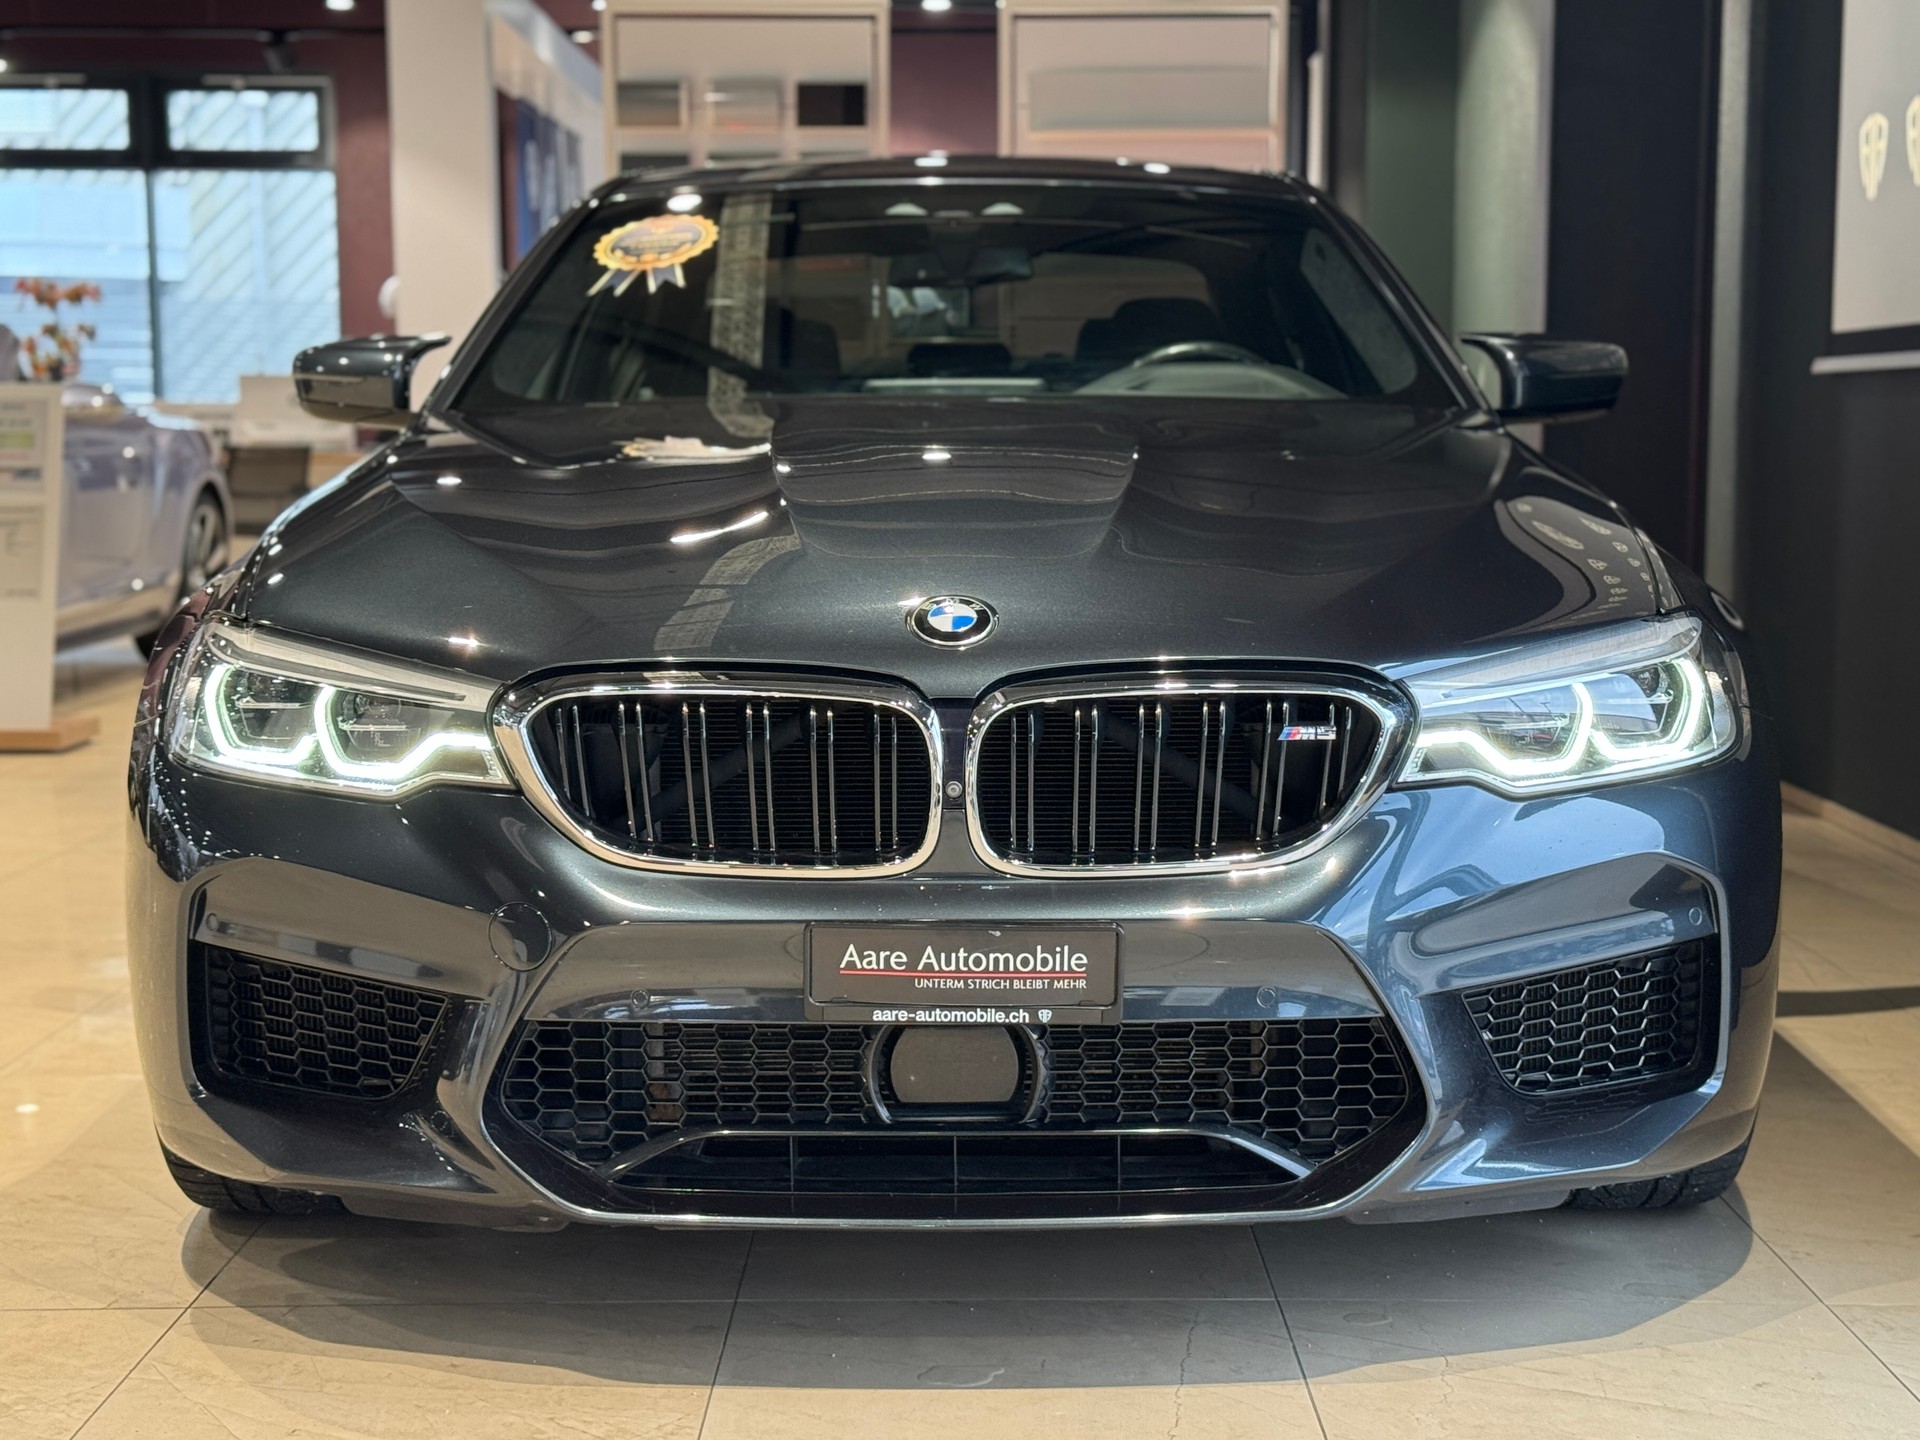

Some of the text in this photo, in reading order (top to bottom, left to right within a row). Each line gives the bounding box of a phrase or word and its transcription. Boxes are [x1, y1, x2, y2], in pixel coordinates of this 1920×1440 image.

[840, 943, 1088, 972] Aare Automobile
[915, 978, 1087, 990] UNTERM STRICH BLEIBT MEHR
[872, 1008, 1030, 1024] aare-automobile.ch
